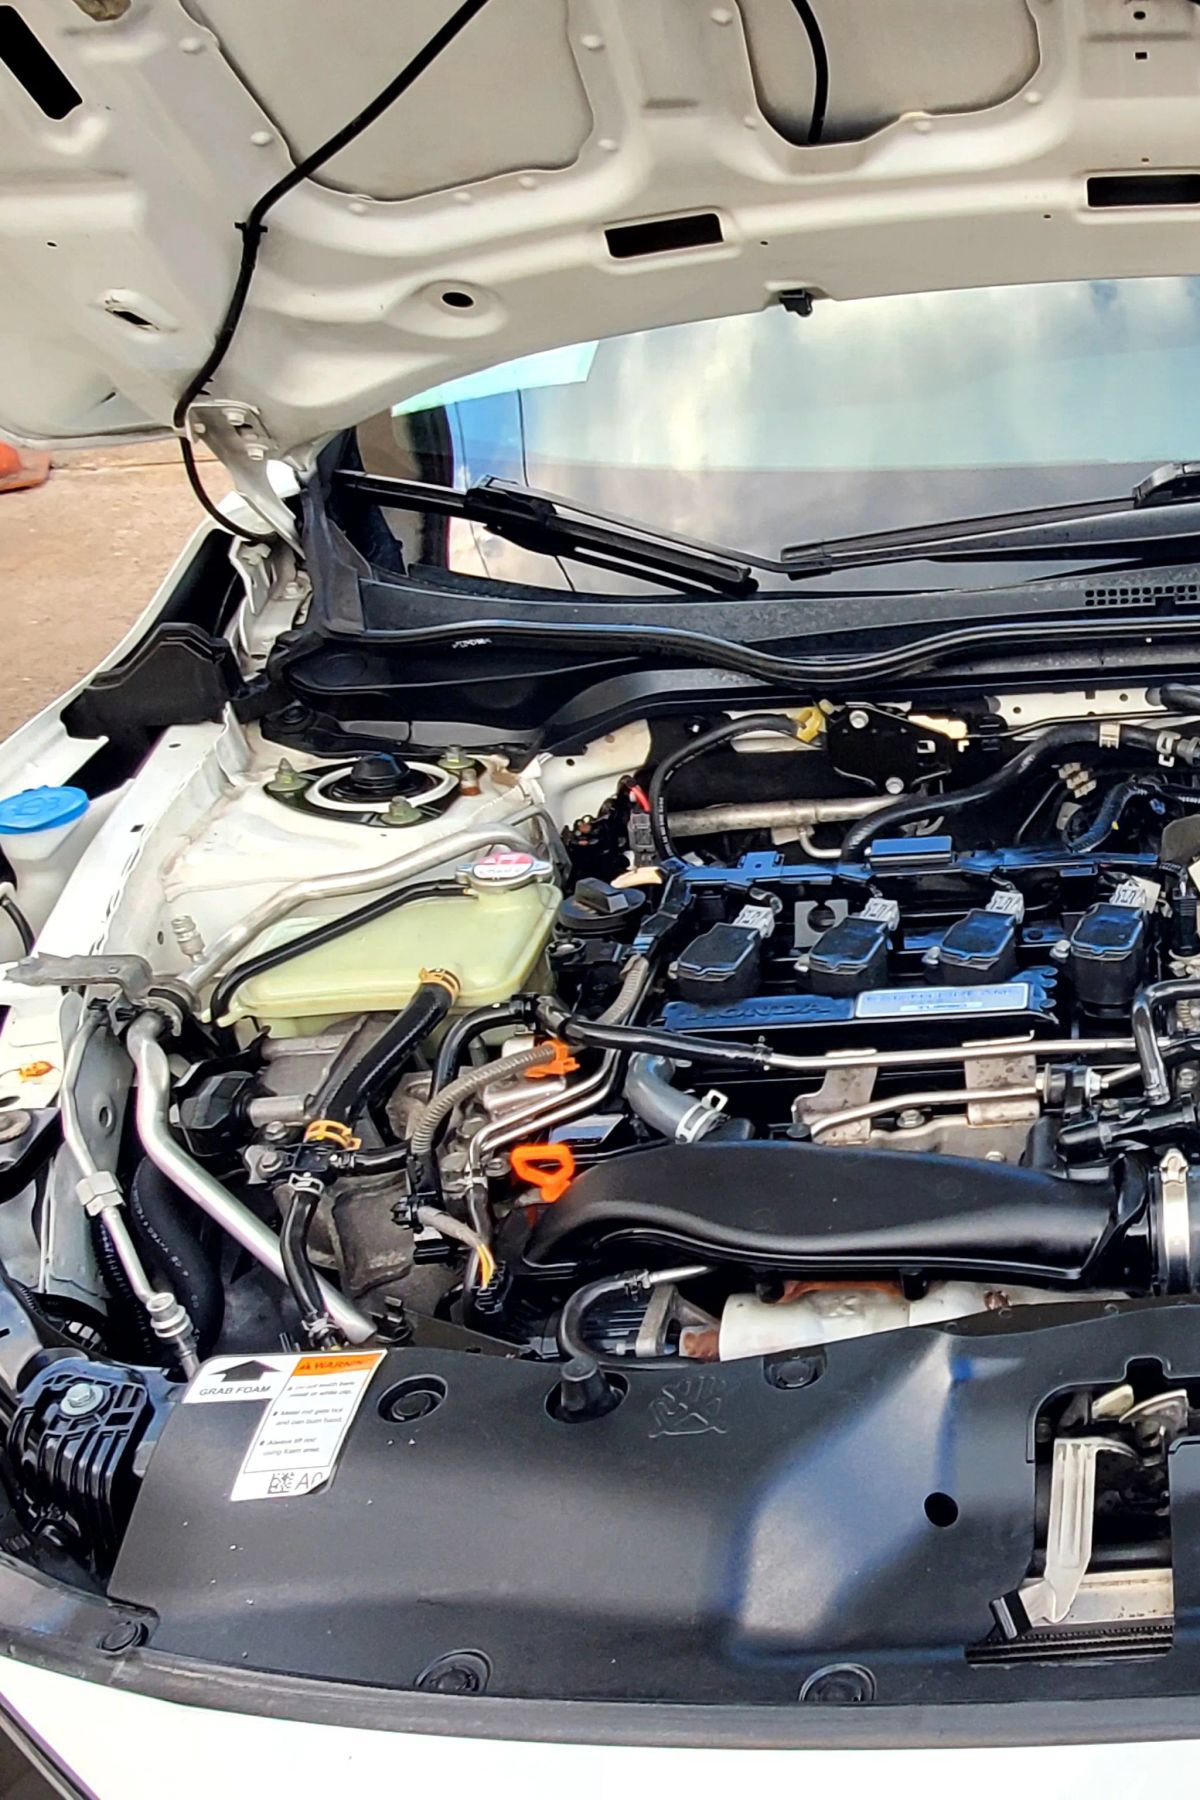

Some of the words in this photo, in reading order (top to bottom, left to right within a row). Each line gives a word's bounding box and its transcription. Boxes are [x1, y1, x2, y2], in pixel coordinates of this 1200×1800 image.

[685, 1002, 831, 1021] HONDA
[199, 1386, 233, 1397] GRAB
[235, 1384, 272, 1395] FOAM
